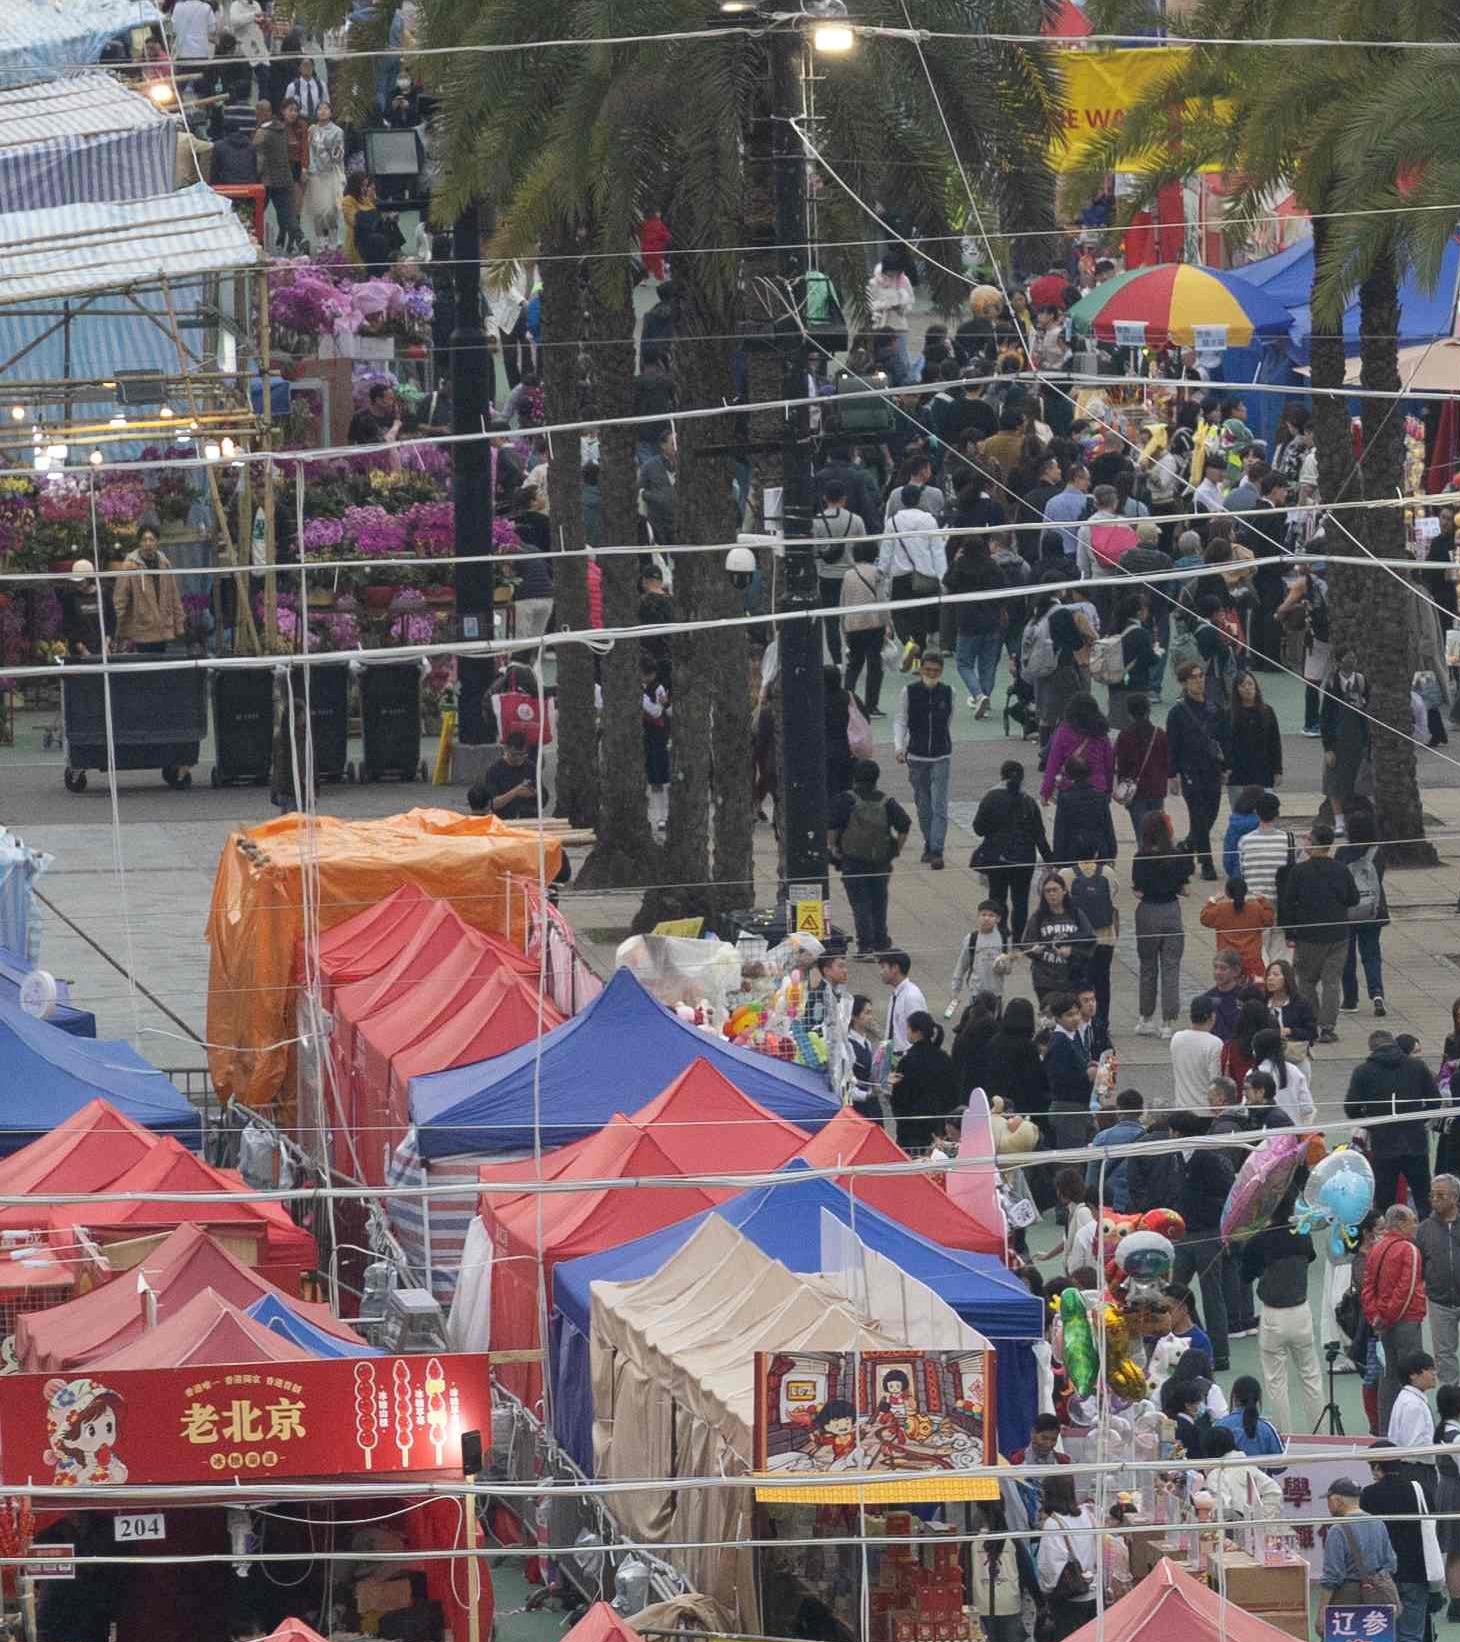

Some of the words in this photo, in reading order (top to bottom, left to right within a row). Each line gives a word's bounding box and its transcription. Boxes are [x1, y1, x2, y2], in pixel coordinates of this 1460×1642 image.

[180, 1397, 306, 1444] 老北京
[120, 1517, 161, 1538] 204
[1333, 1609, 1389, 1637] 辽参
